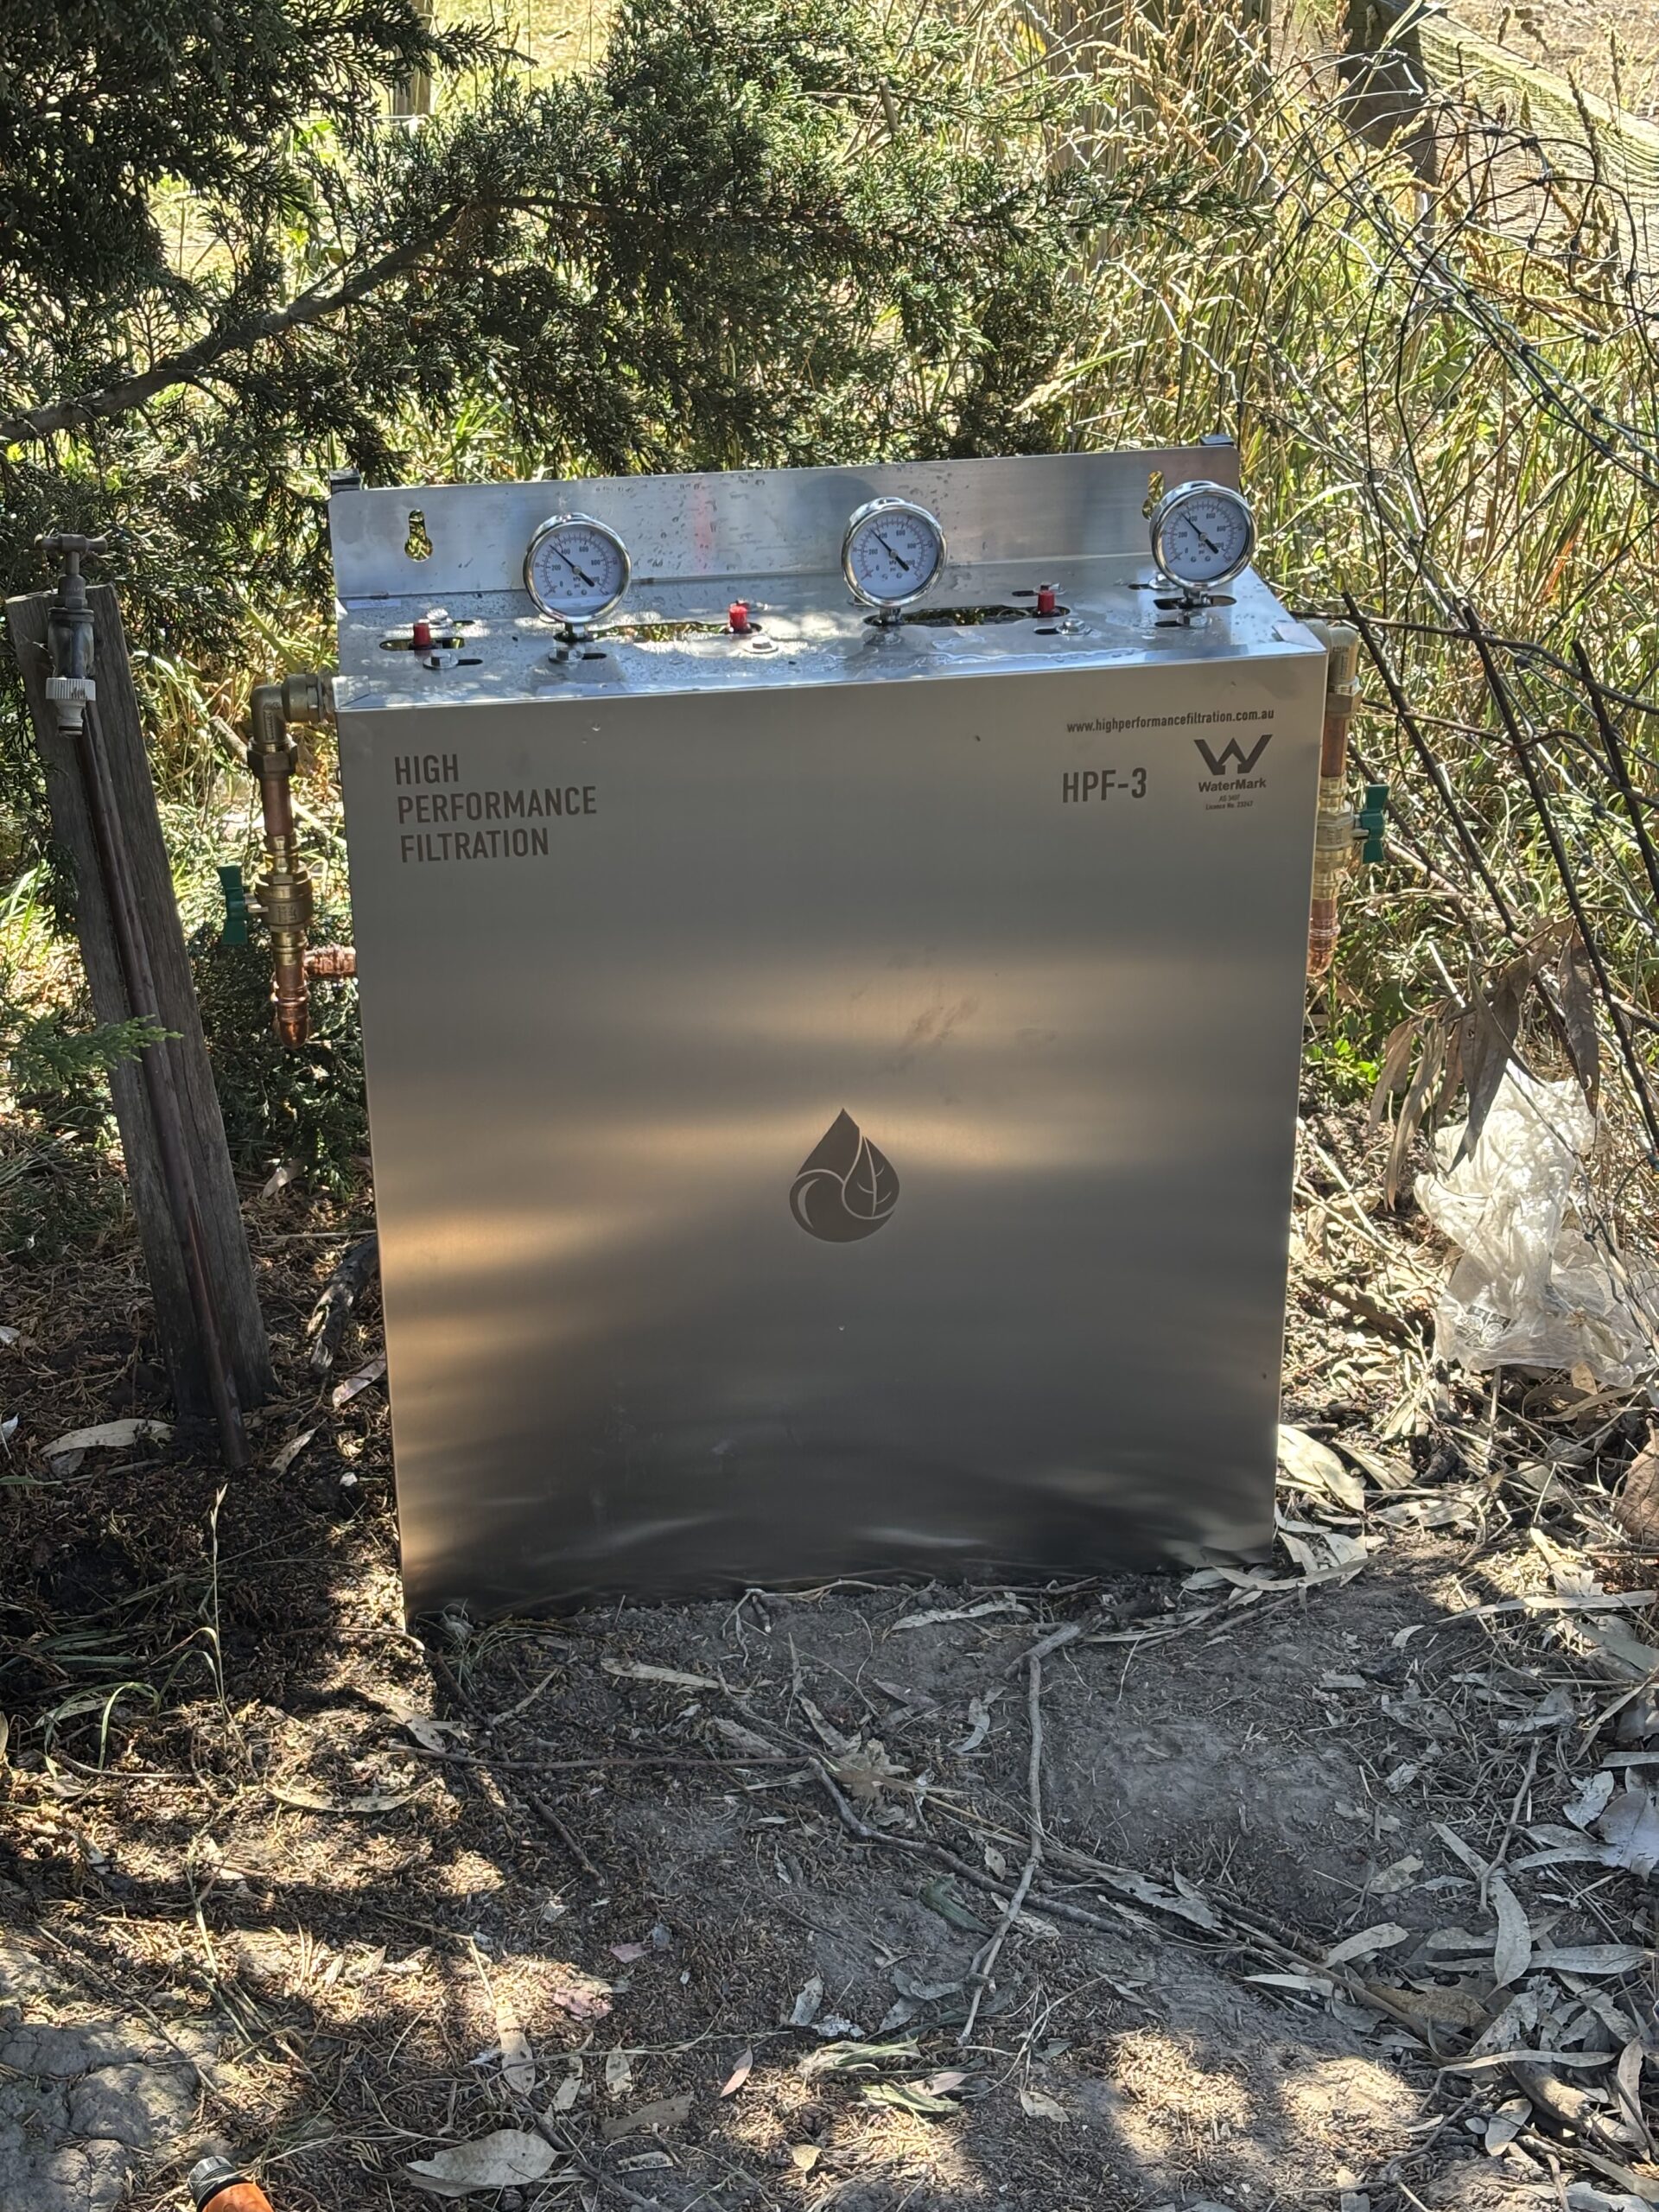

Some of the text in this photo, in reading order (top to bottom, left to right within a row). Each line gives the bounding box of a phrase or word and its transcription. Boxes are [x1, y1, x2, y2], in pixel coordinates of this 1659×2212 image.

[1066, 709, 1274, 733] www.highperformancefiltration.com.au
[394, 753, 459, 785] HIGH
[1062, 767, 1147, 804] HPF-3
[1198, 778, 1267, 792] WaterMark
[397, 785, 597, 824] PERFORMANCE
[400, 827, 550, 863] FILTRATION
